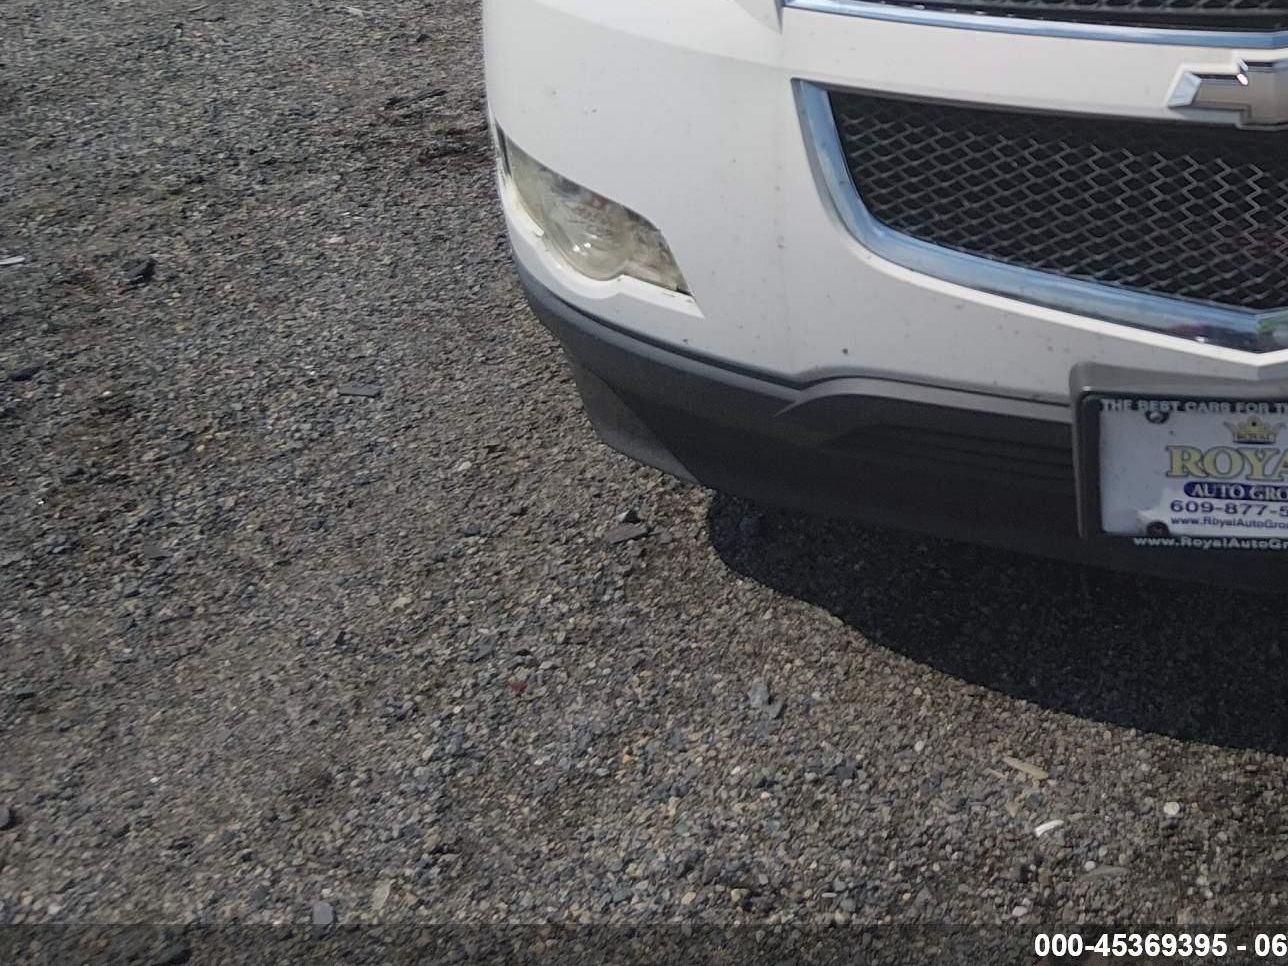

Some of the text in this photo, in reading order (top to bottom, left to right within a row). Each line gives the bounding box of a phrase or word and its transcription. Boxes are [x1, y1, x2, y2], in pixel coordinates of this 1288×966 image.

[1101, 398, 1132, 410] THE
[1138, 399, 1182, 411] BEST
[1184, 401, 1231, 412] CARS
[1235, 402, 1269, 413] FOR
[1192, 484, 1245, 499] AUTO
